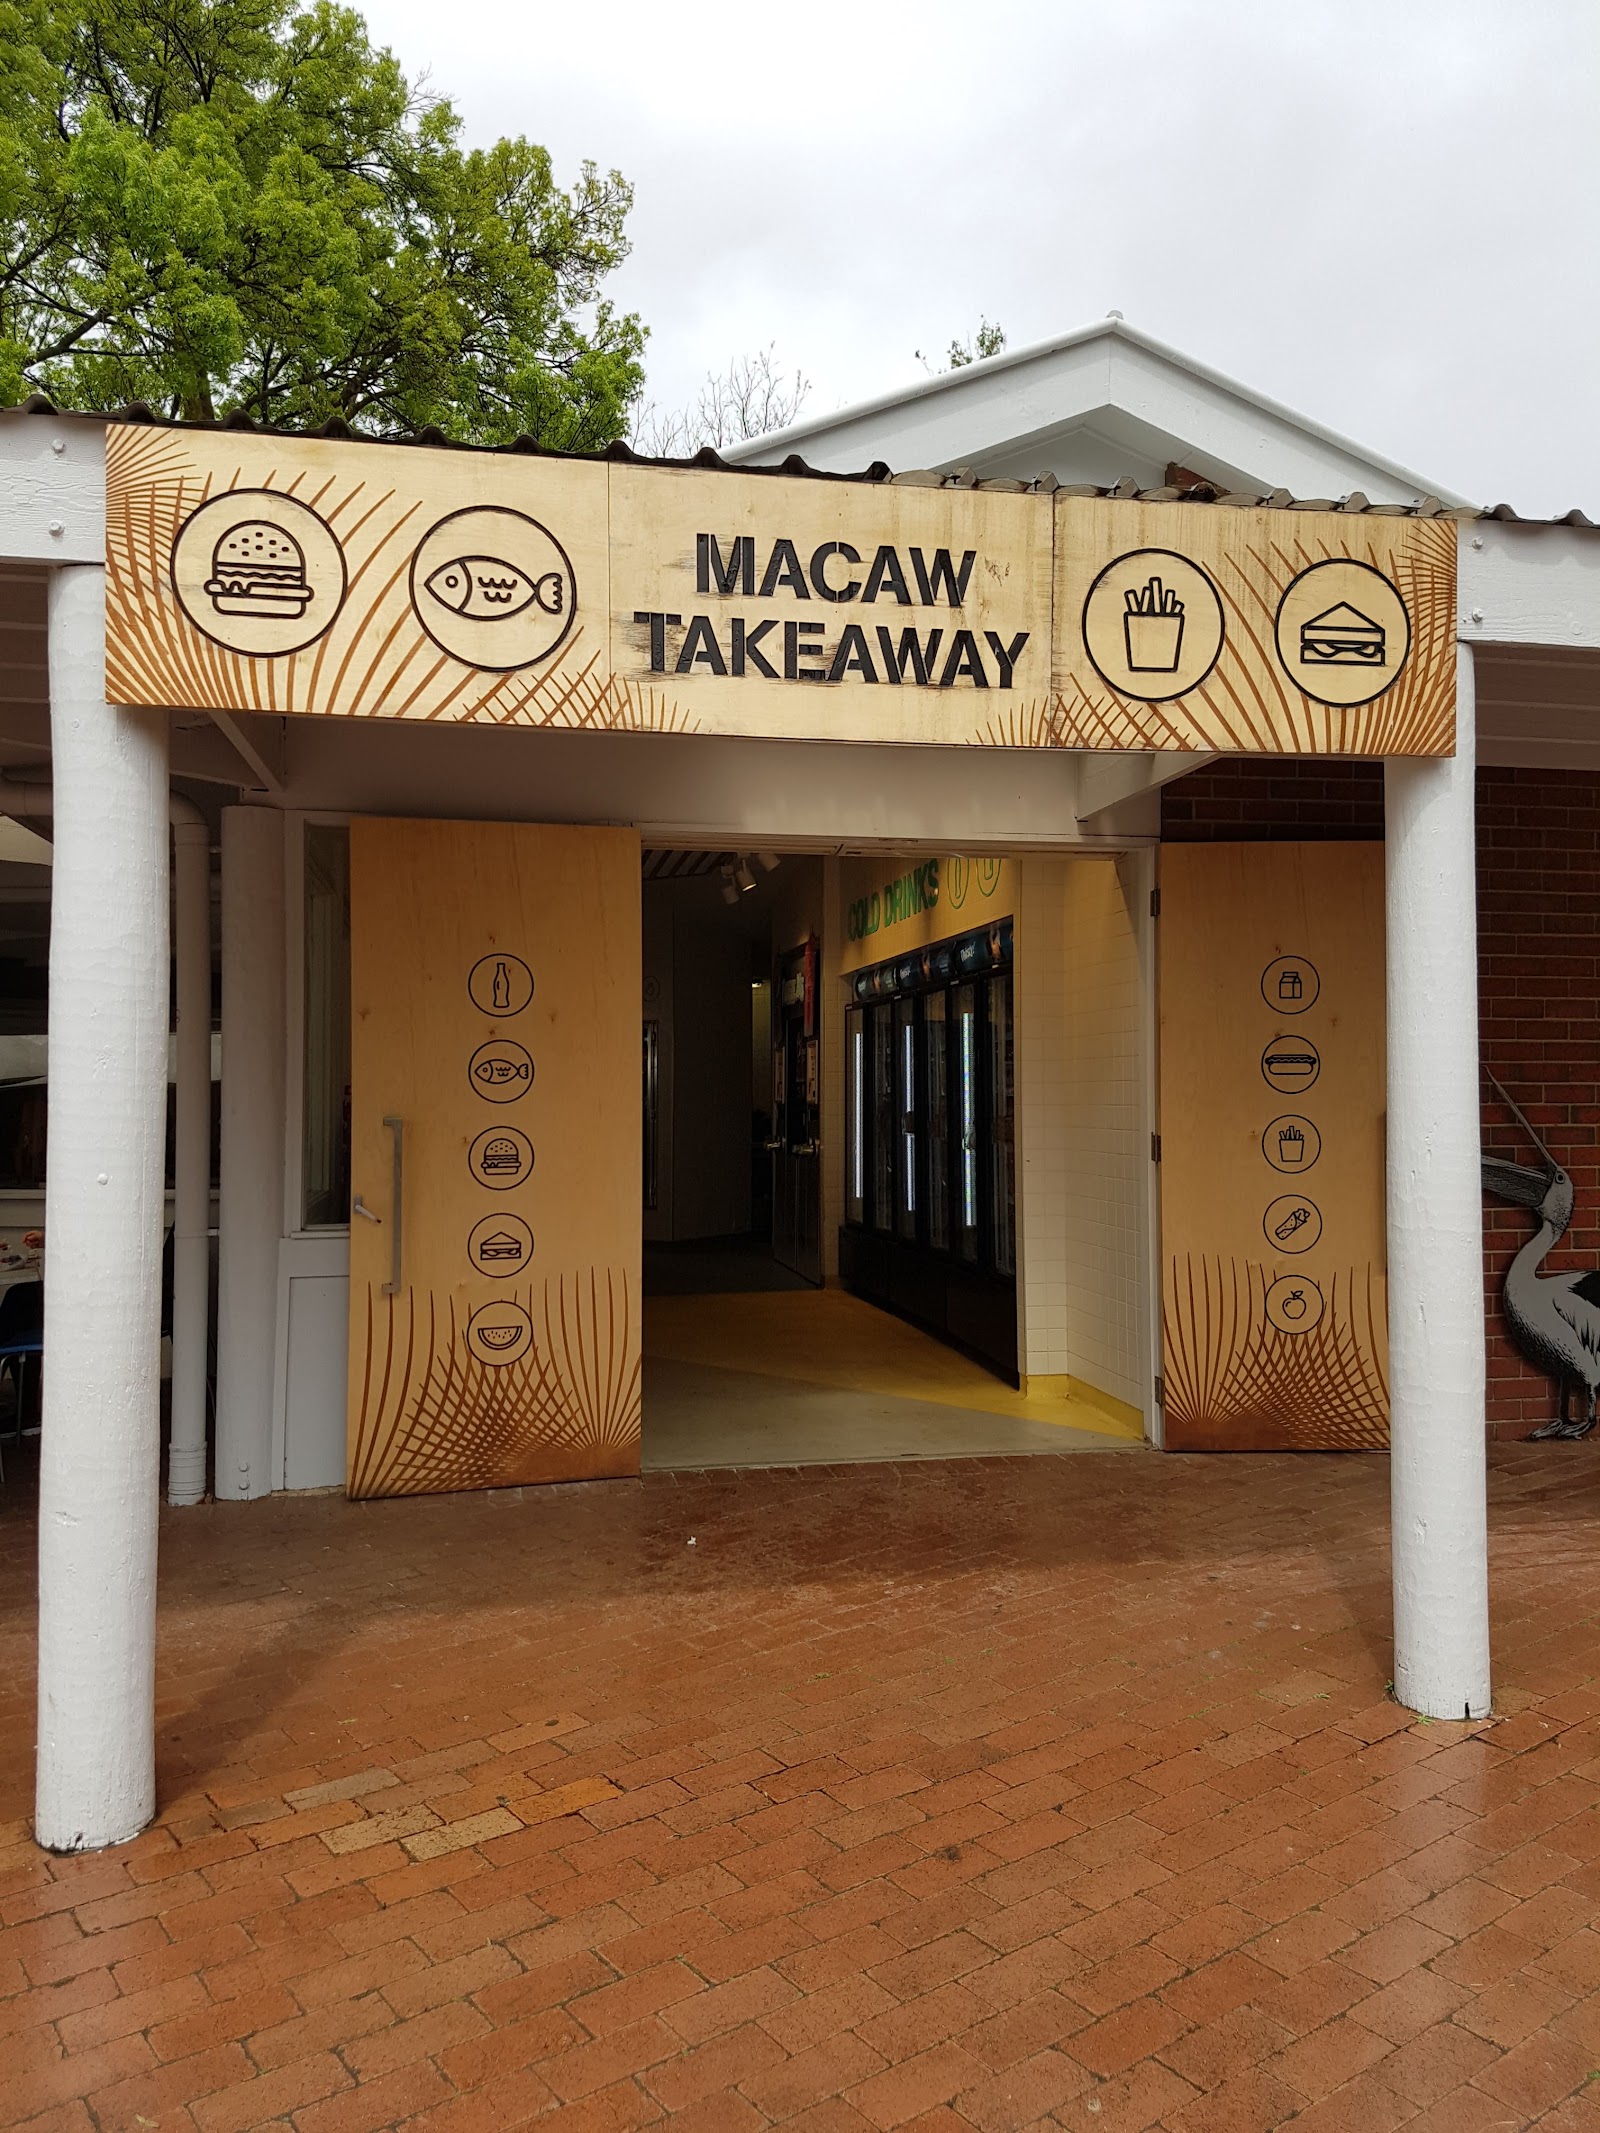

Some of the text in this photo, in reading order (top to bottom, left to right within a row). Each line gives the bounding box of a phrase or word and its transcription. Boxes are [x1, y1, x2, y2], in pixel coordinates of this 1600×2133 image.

[696, 533, 977, 608] MACAW
[633, 611, 1030, 689] TAKEAWAY
[849, 858, 939, 941] COLD DRINKS
